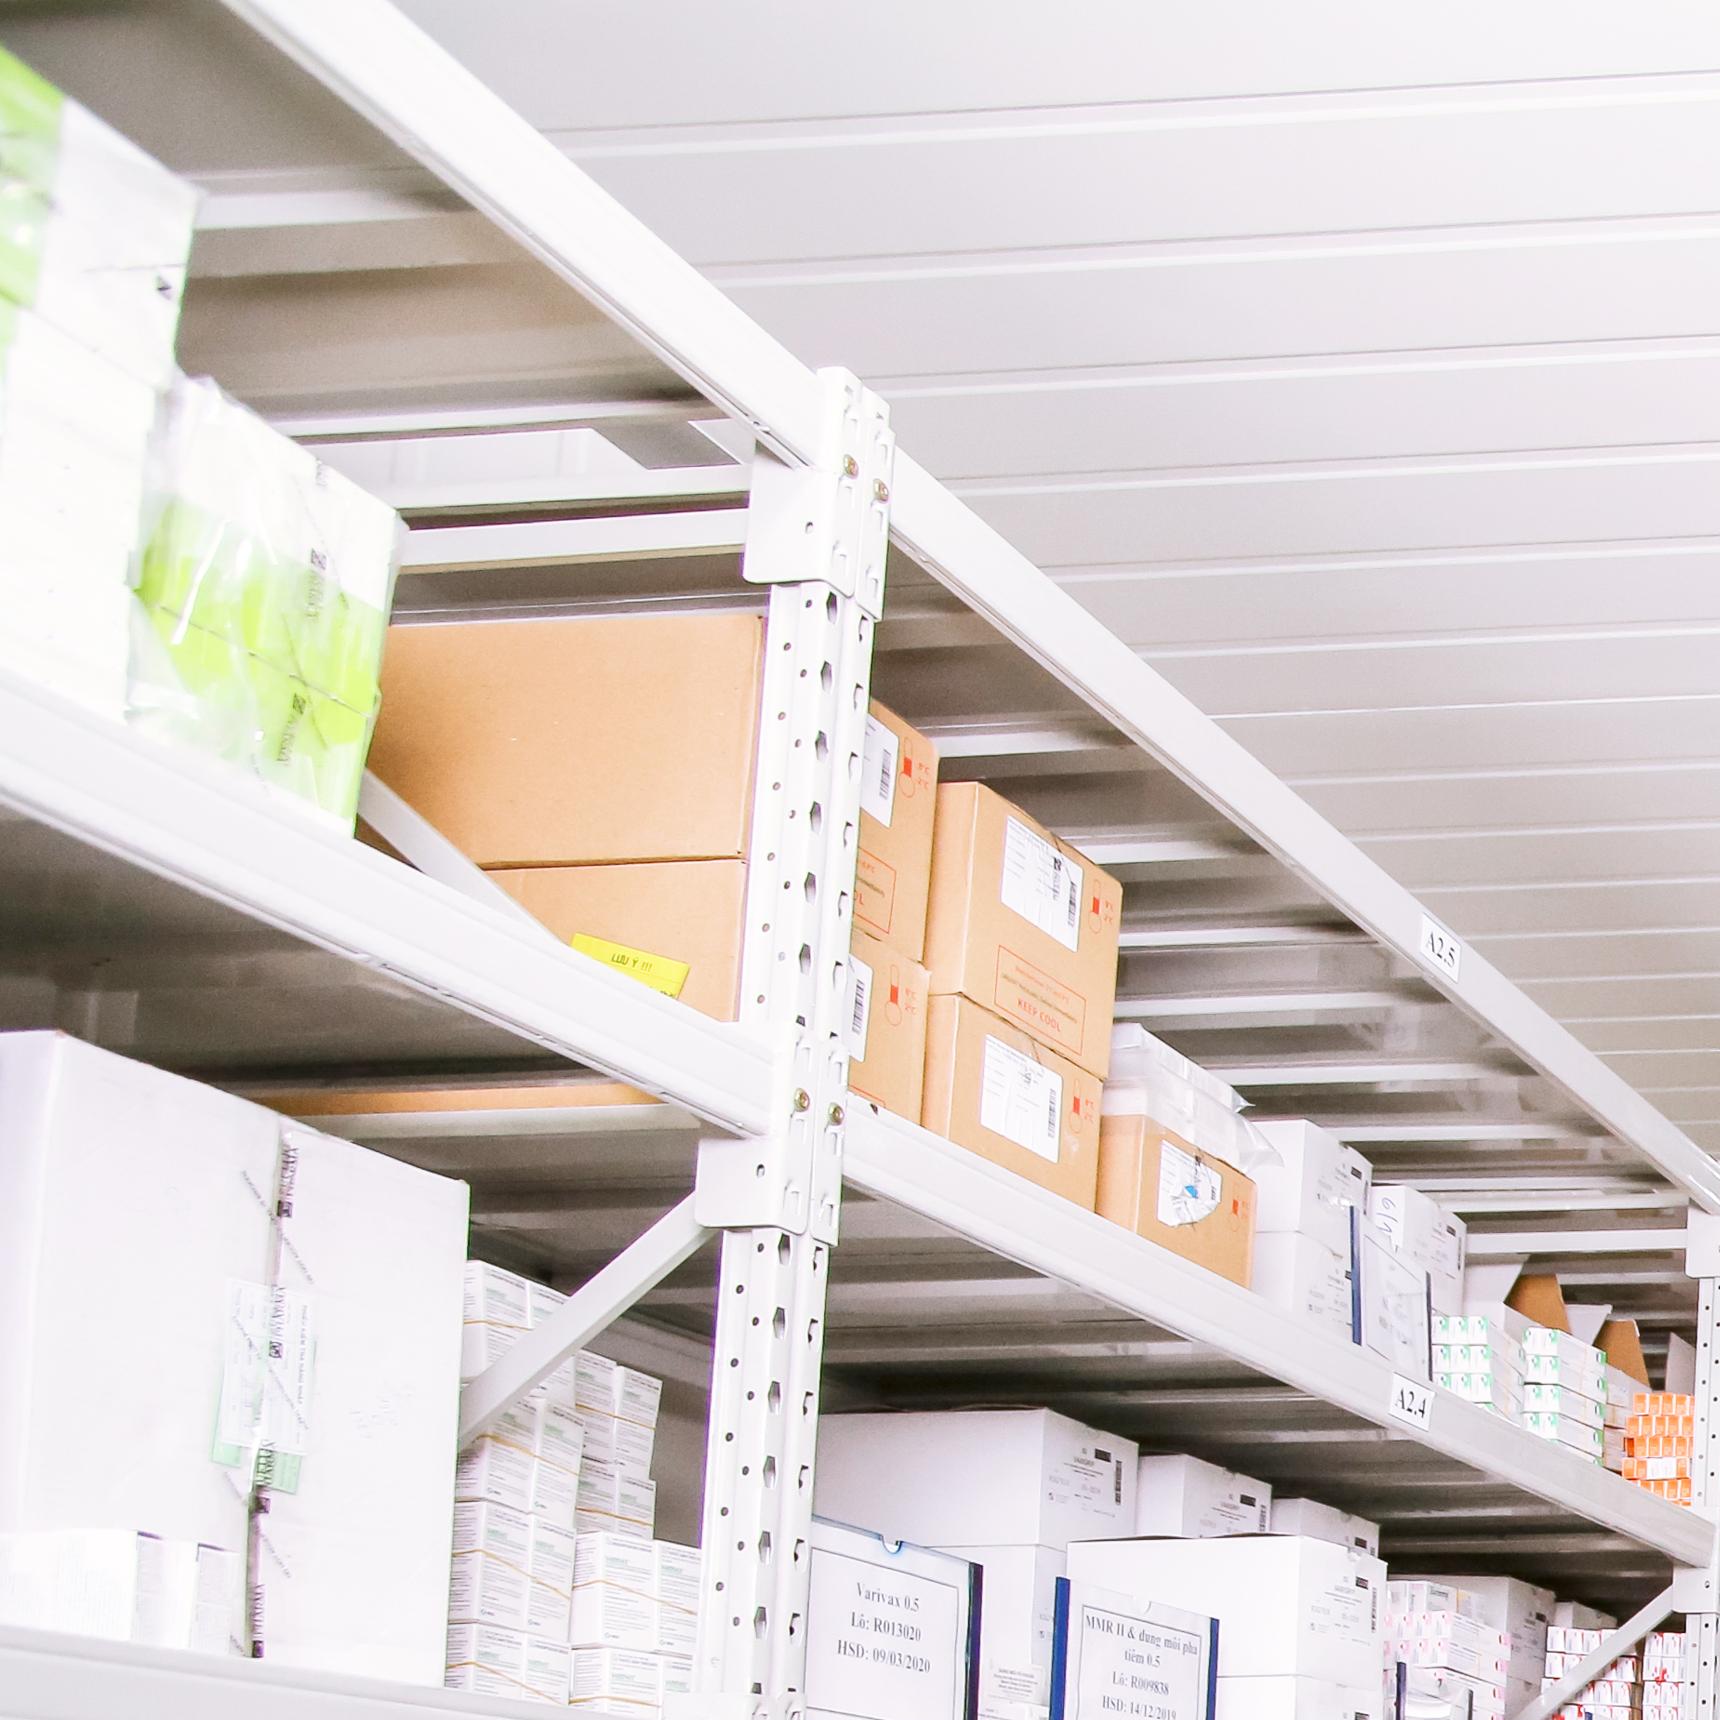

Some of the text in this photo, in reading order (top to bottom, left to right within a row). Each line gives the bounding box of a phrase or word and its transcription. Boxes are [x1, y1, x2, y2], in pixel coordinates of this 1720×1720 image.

[1425, 931, 1456, 968] A2.5
[1017, 999, 1061, 1032] KEEP COOL
[1394, 1387, 1426, 1419] A2.4
[857, 1581, 920, 1612] Varivax 0.5
[850, 1611, 921, 1642] Lô: R013020
[1085, 1614, 1114, 1638] MMR
[1127, 1626, 1136, 1640] &
[1182, 1638, 1198, 1657] pha
[837, 1639, 931, 1673] HSD: 09/03/2020
[1146, 1652, 1161, 1668] 0.5
[1102, 1696, 1128, 1713] HSD:
